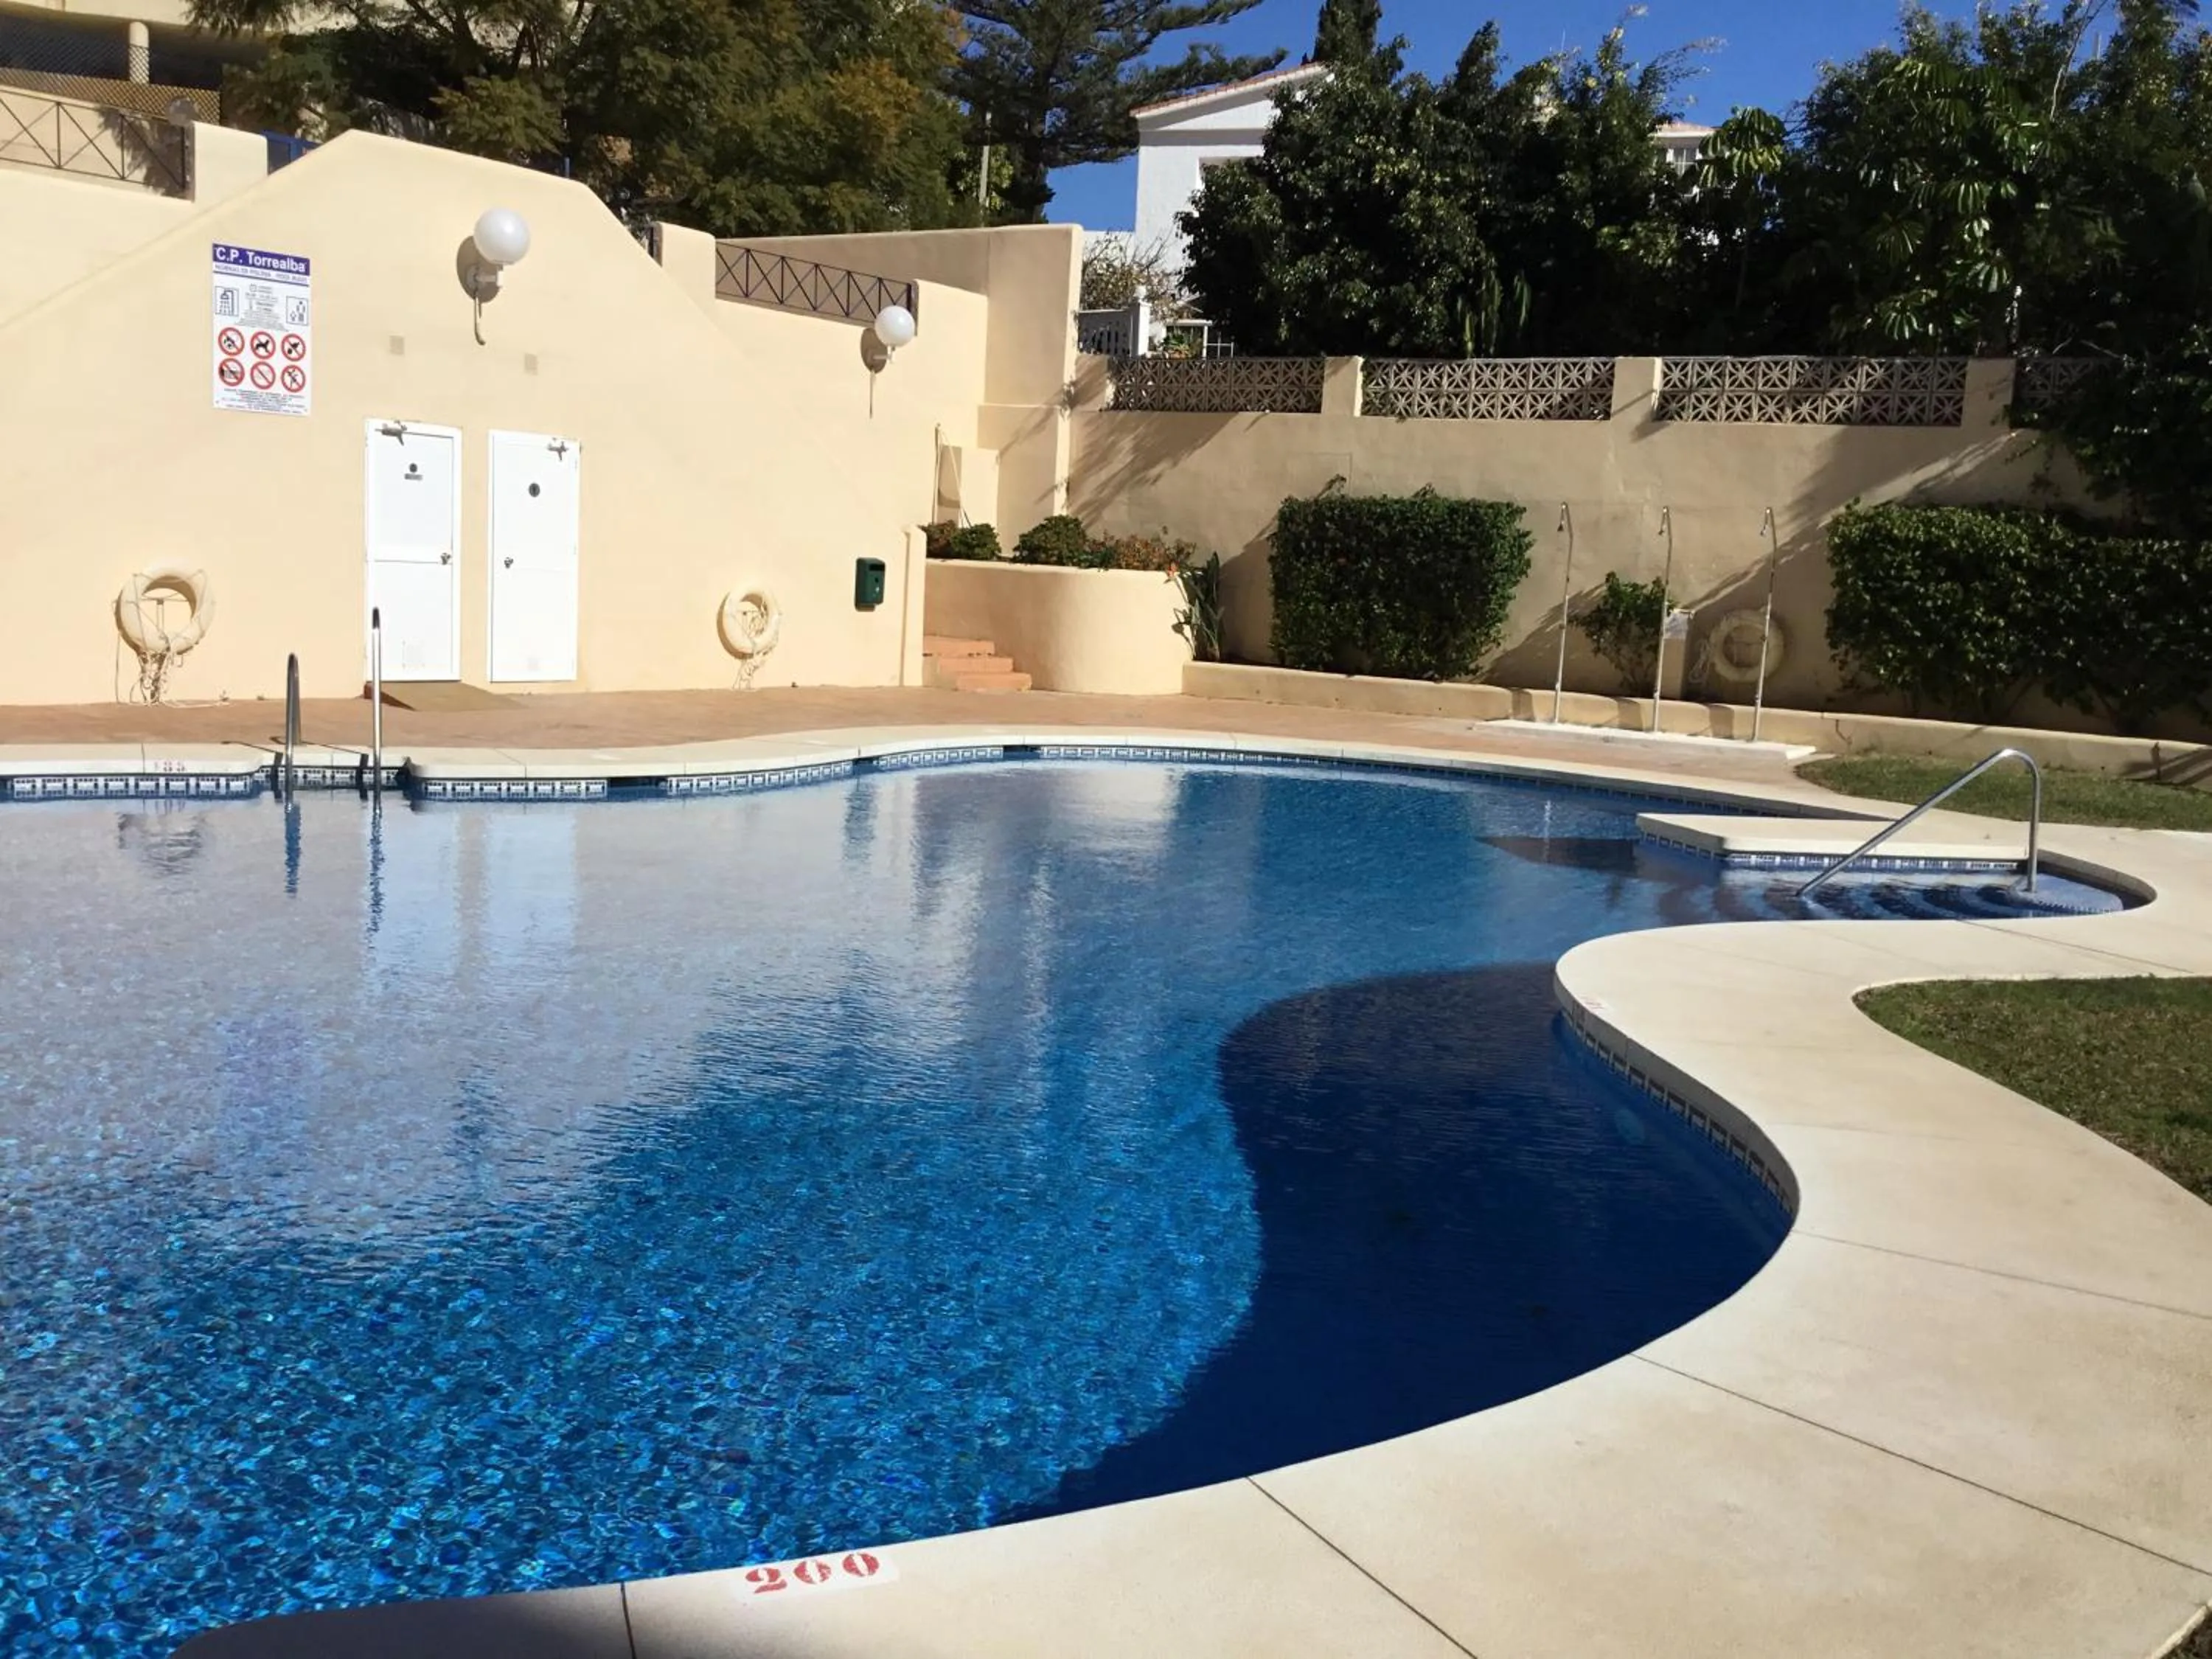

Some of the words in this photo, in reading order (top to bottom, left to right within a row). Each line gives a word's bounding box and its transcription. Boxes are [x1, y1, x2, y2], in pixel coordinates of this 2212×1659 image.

[215, 247, 243, 263] C.P.
[246, 251, 306, 272] Torrealba
[745, 1553, 880, 1594] 200
